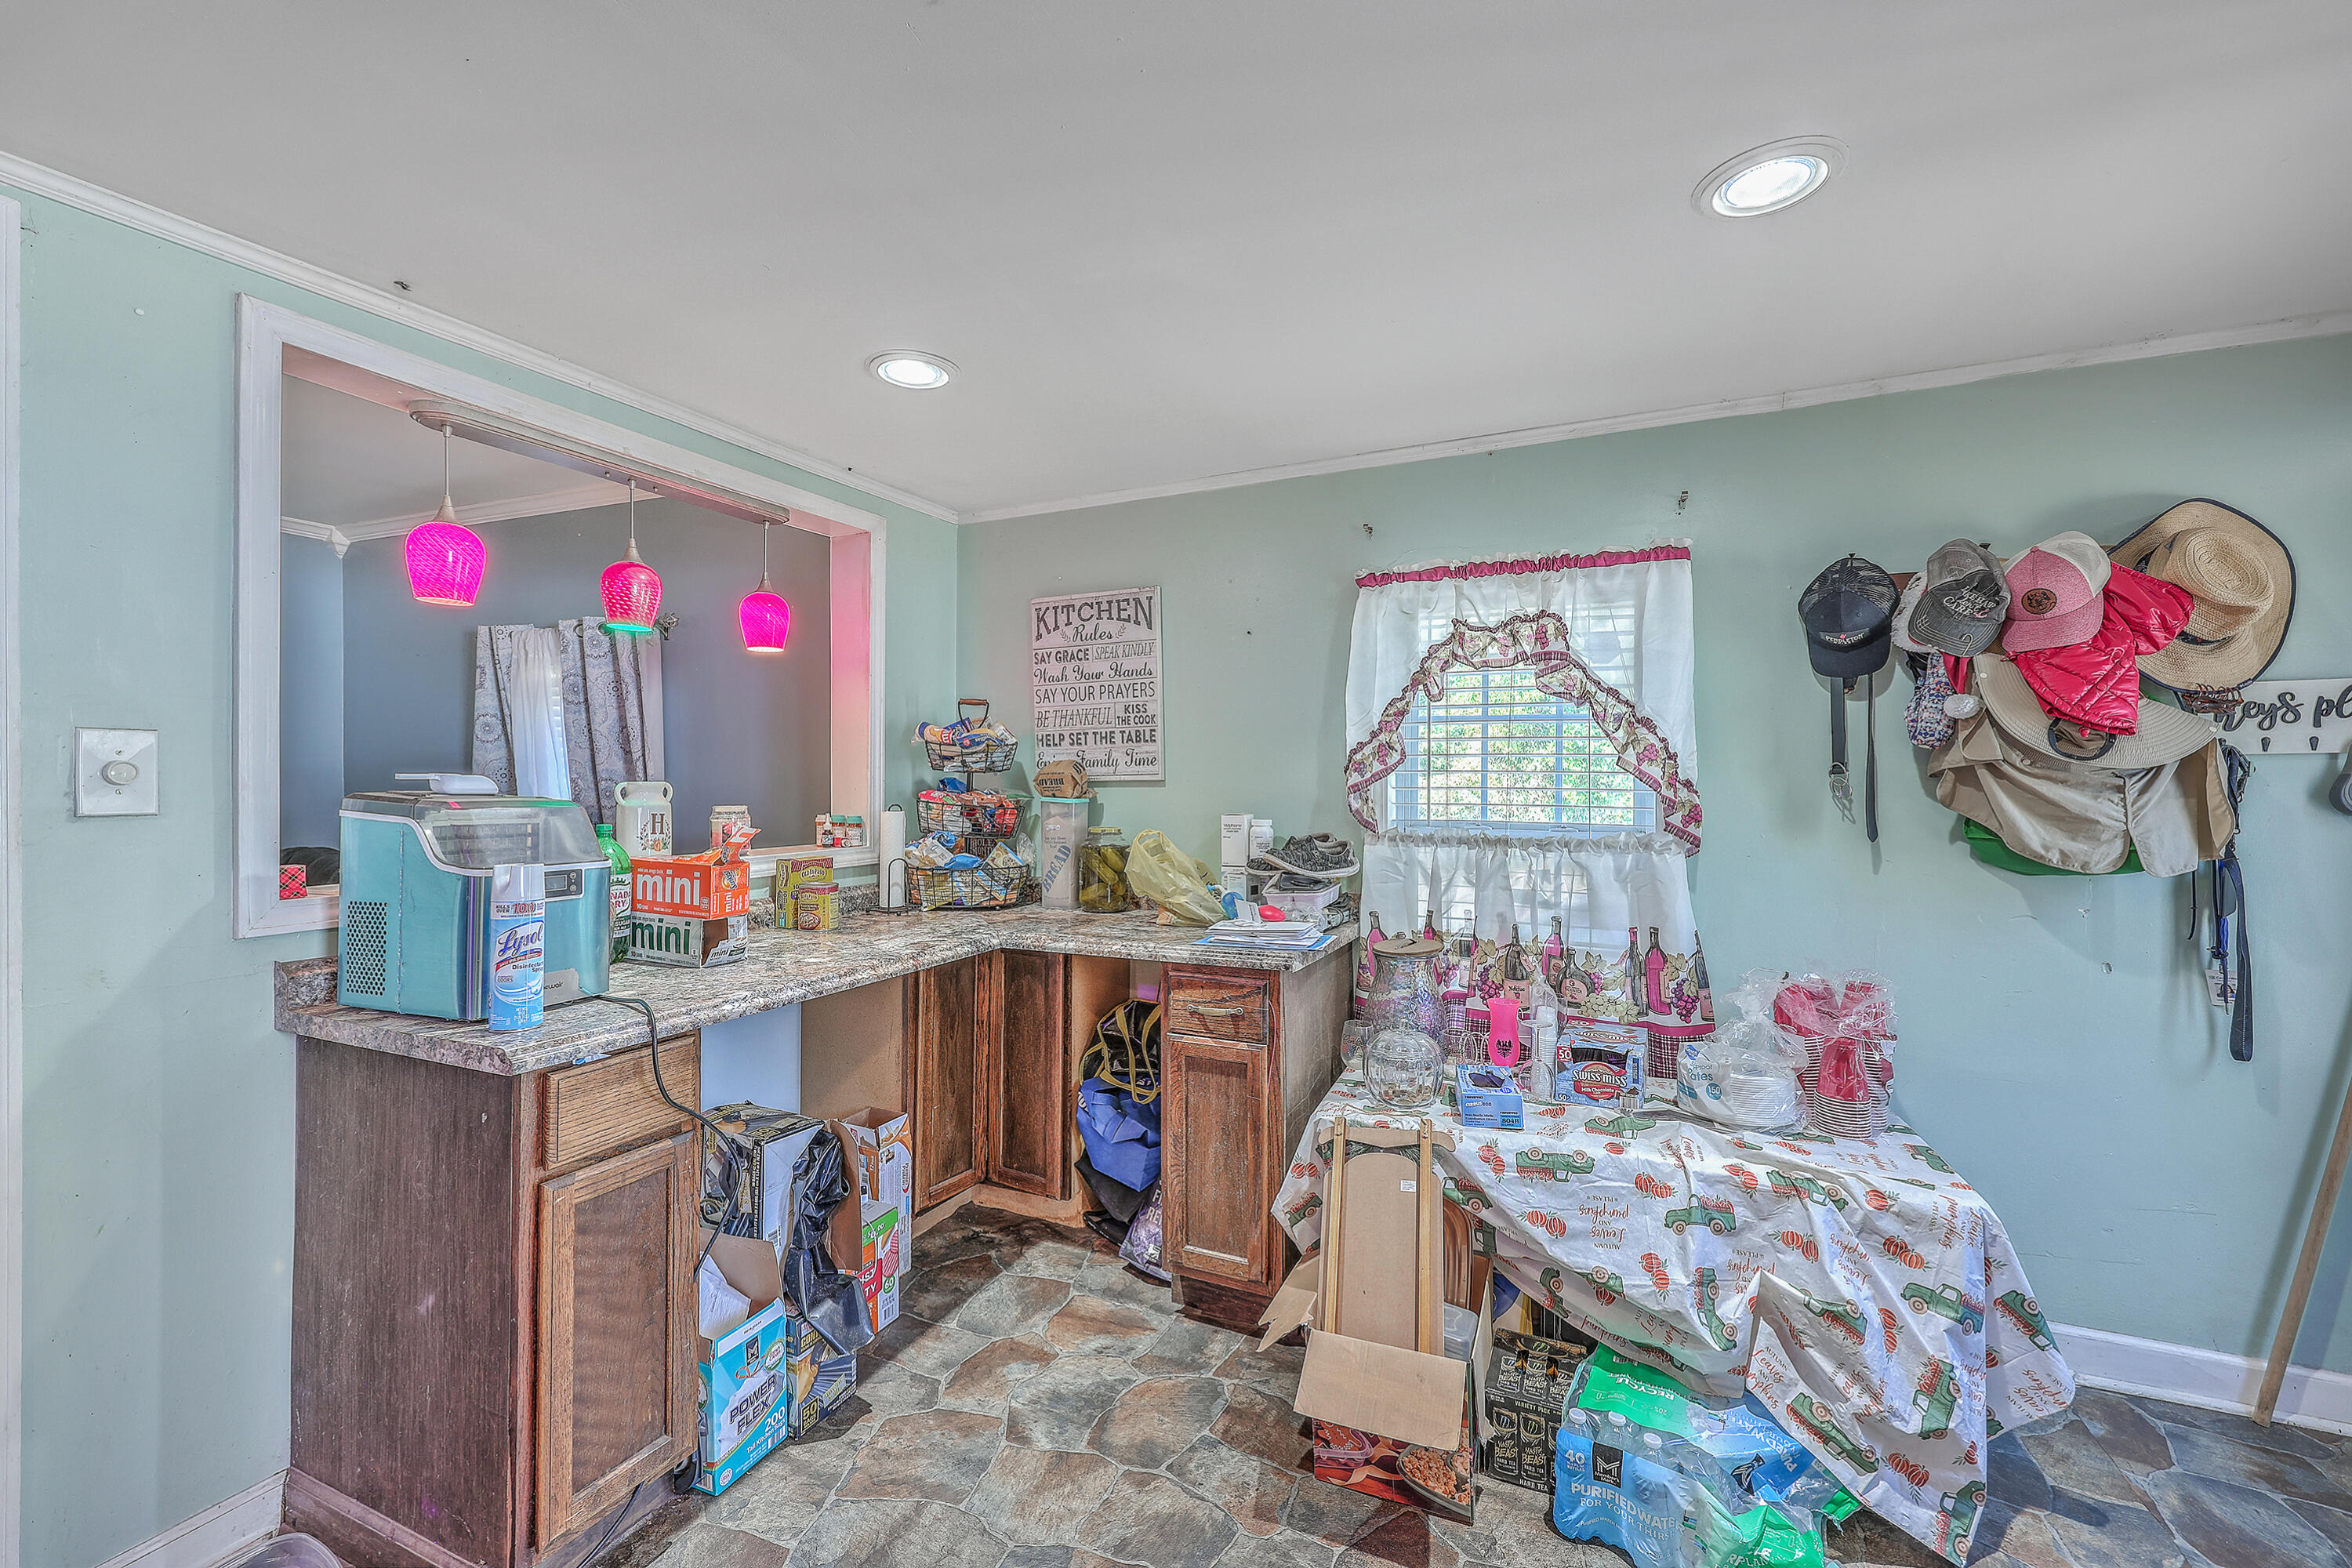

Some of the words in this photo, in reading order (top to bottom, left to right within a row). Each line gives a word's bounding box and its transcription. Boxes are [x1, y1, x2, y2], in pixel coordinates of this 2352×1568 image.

[1944, 597, 1973, 615] CARE
[1035, 596, 1153, 642] KITCHEN
[1073, 623, 1113, 642] Rules
[1825, 632, 1864, 644] PENDLETON
[1034, 652, 1052, 665] SAY
[1055, 648, 1090, 663] GRACE
[1094, 646, 1120, 660] SPEAK
[1122, 642, 1155, 659] KINDLY
[1033, 666, 1069, 684] Wash
[1073, 665, 1104, 681] Your
[1109, 662, 1154, 679] Hands
[1035, 688, 1057, 704] SAY
[1060, 685, 1095, 702] YOUR
[1099, 681, 1156, 701] PRAYERS
[1124, 704, 1148, 714] KISS
[2313, 684, 2352, 728] pl
[1036, 712, 1050, 728] BE
[1053, 707, 1113, 728] THANKFUL
[1116, 715, 1131, 726] THE
[1134, 714, 1156, 726] COOK
[1036, 733, 1065, 748] HELP
[1069, 732, 1089, 746] SET
[1093, 731, 1116, 746] THE
[1120, 728, 1156, 745] TABLE
[1076, 750, 1120, 775] Family
[1125, 748, 1157, 768] Time
[651, 813, 665, 834] H
[1042, 845, 1073, 892] BREAD
[637, 869, 701, 906] mini
[497, 924, 543, 956] Lysol
[632, 918, 691, 955] mini
[710, 949, 729, 958] mini
[1559, 1049, 1572, 1059] 50
[1708, 1086, 1720, 1094] 150
[1579, 1203, 1629, 1225] pumpkins
[1590, 1225, 1626, 1243] Leaves
[884, 1277, 894, 1290] 60
[1752, 1348, 1784, 1384] Leaves
[1764, 1345, 1789, 1371] AUTUMN
[1525, 1380, 1548, 1388] BEAST
[1758, 1369, 1769, 1382] AND
[1616, 1377, 1675, 1401] RECYCLE
[730, 1374, 777, 1425] POWER
[1515, 1400, 1536, 1410] VARIETY
[1537, 1406, 1551, 1414] PACK
[737, 1399, 771, 1435] FLEX
[765, 1406, 786, 1432] 200
[803, 1402, 817, 1421] 50
[746, 1443, 757, 1454] Tall
[757, 1428, 775, 1446] Kitchen
[1497, 1440, 1515, 1449] NASTY
[1525, 1446, 1542, 1455] NASTY
[1496, 1447, 1519, 1458] BEAST
[1522, 1454, 1547, 1466] BEAST
[1565, 1450, 1585, 1465] 40
[1519, 1479, 1535, 1488] HARD
[1595, 1471, 1620, 1483] Member's
[1571, 1483, 1637, 1515] PURIFIED
[1636, 1508, 1686, 1535] WATER
[1581, 1497, 1602, 1507] FOR
[1606, 1501, 1635, 1526] YOUR
[1637, 1522, 1675, 1541] THIRST
